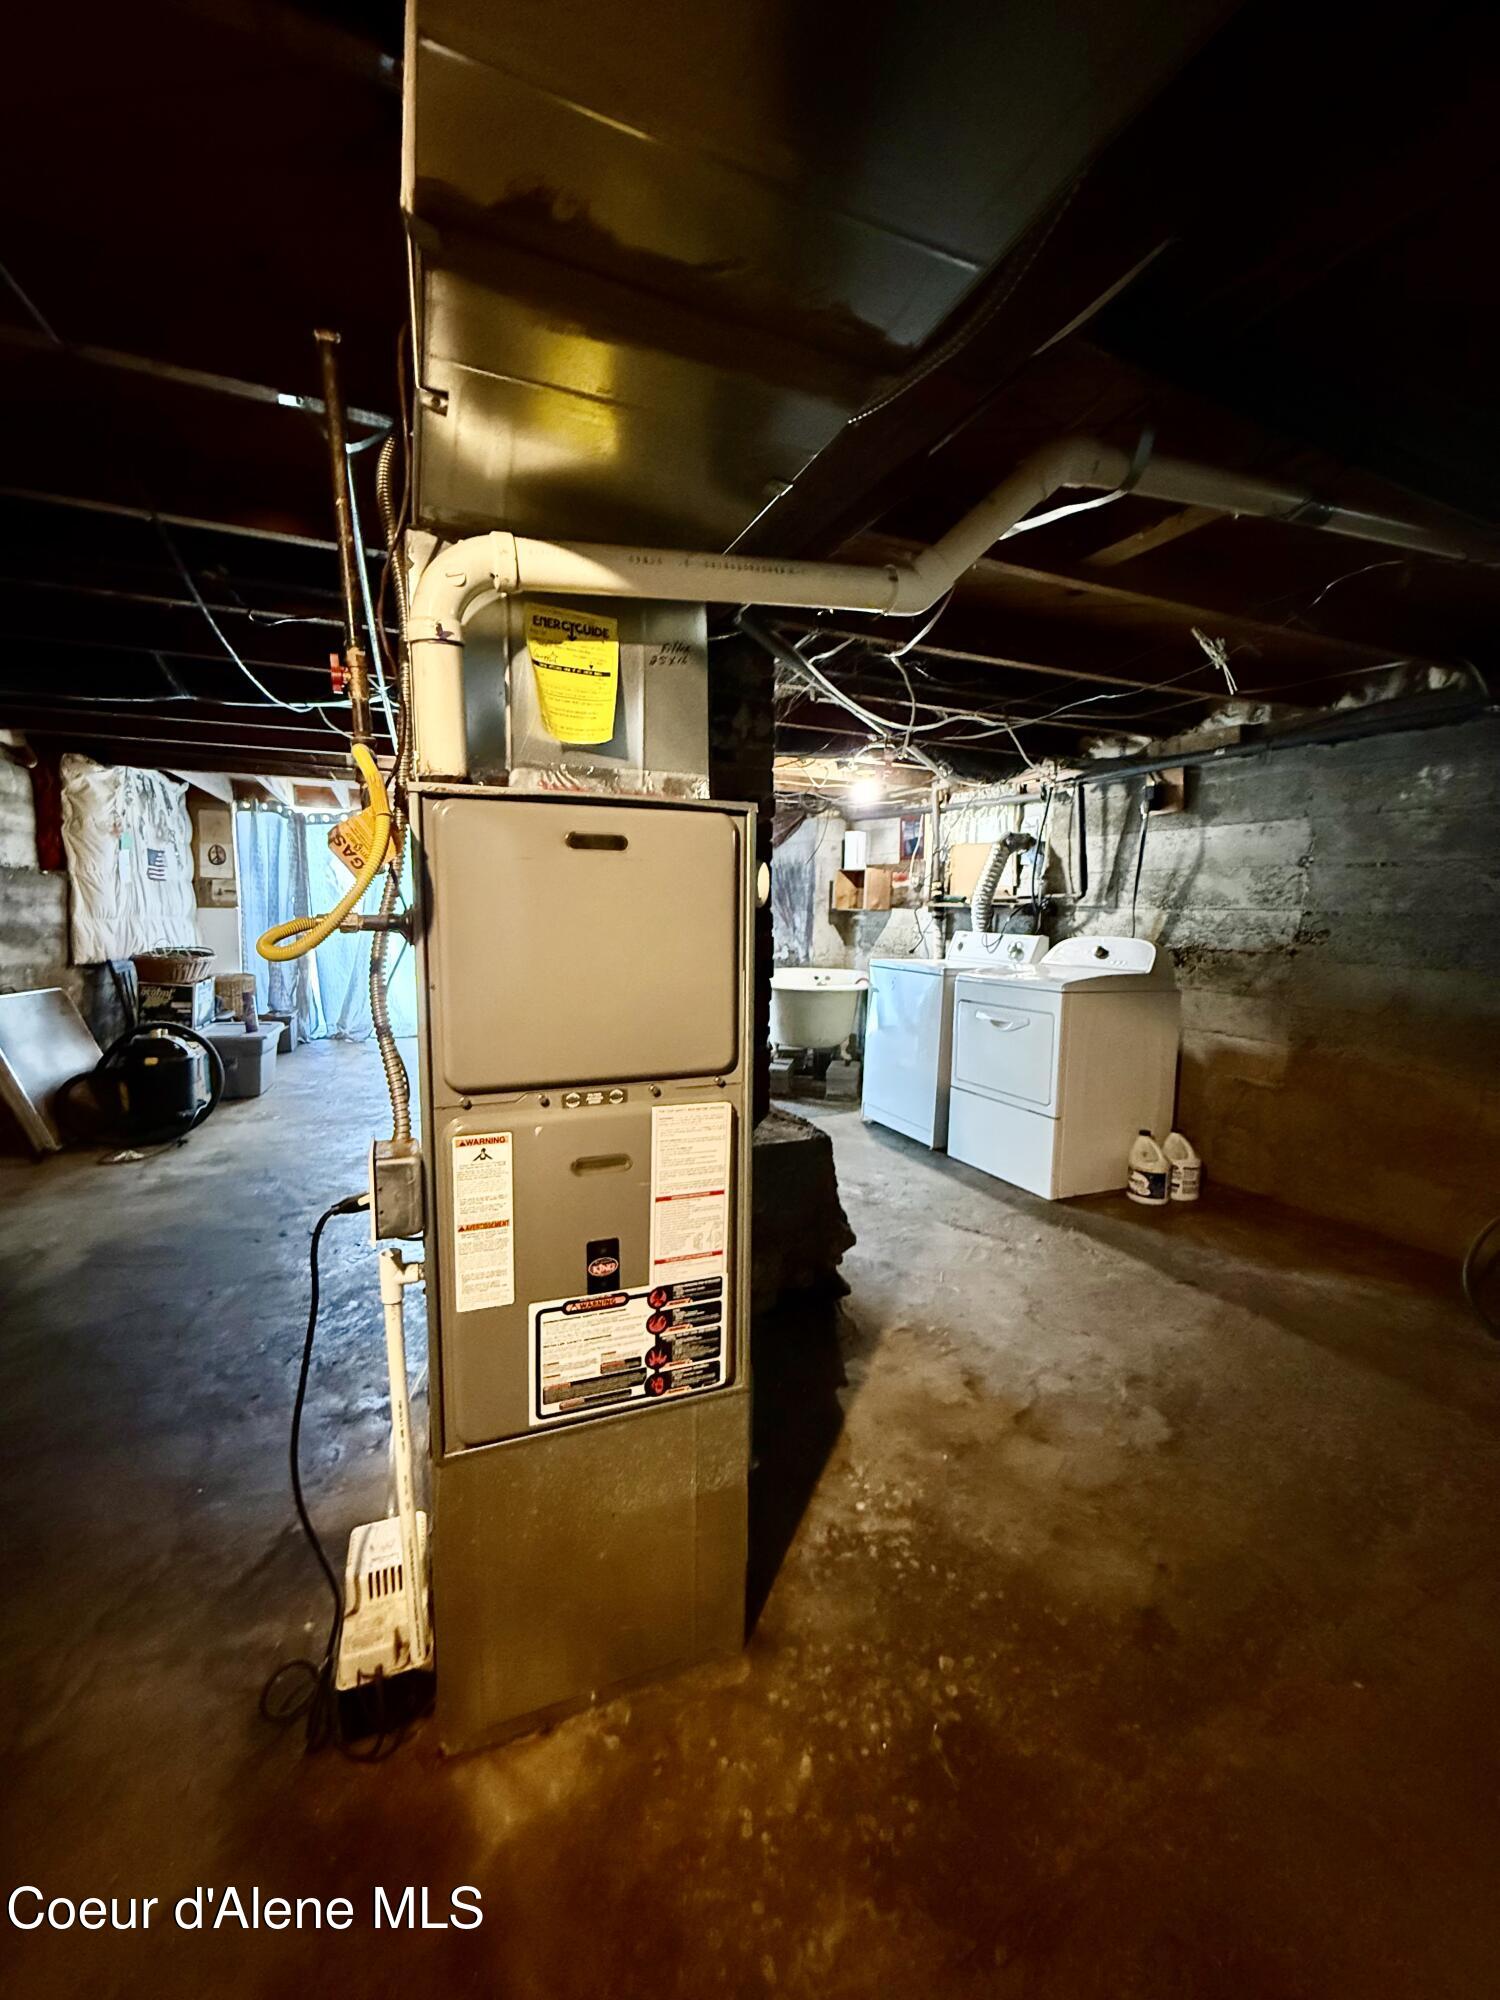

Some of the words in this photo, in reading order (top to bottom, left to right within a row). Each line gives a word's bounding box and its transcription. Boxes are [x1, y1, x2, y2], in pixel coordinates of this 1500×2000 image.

[333, 834, 365, 870] GAS
[465, 1136, 506, 1147] WARNING
[580, 1297, 616, 1309] WARNING
